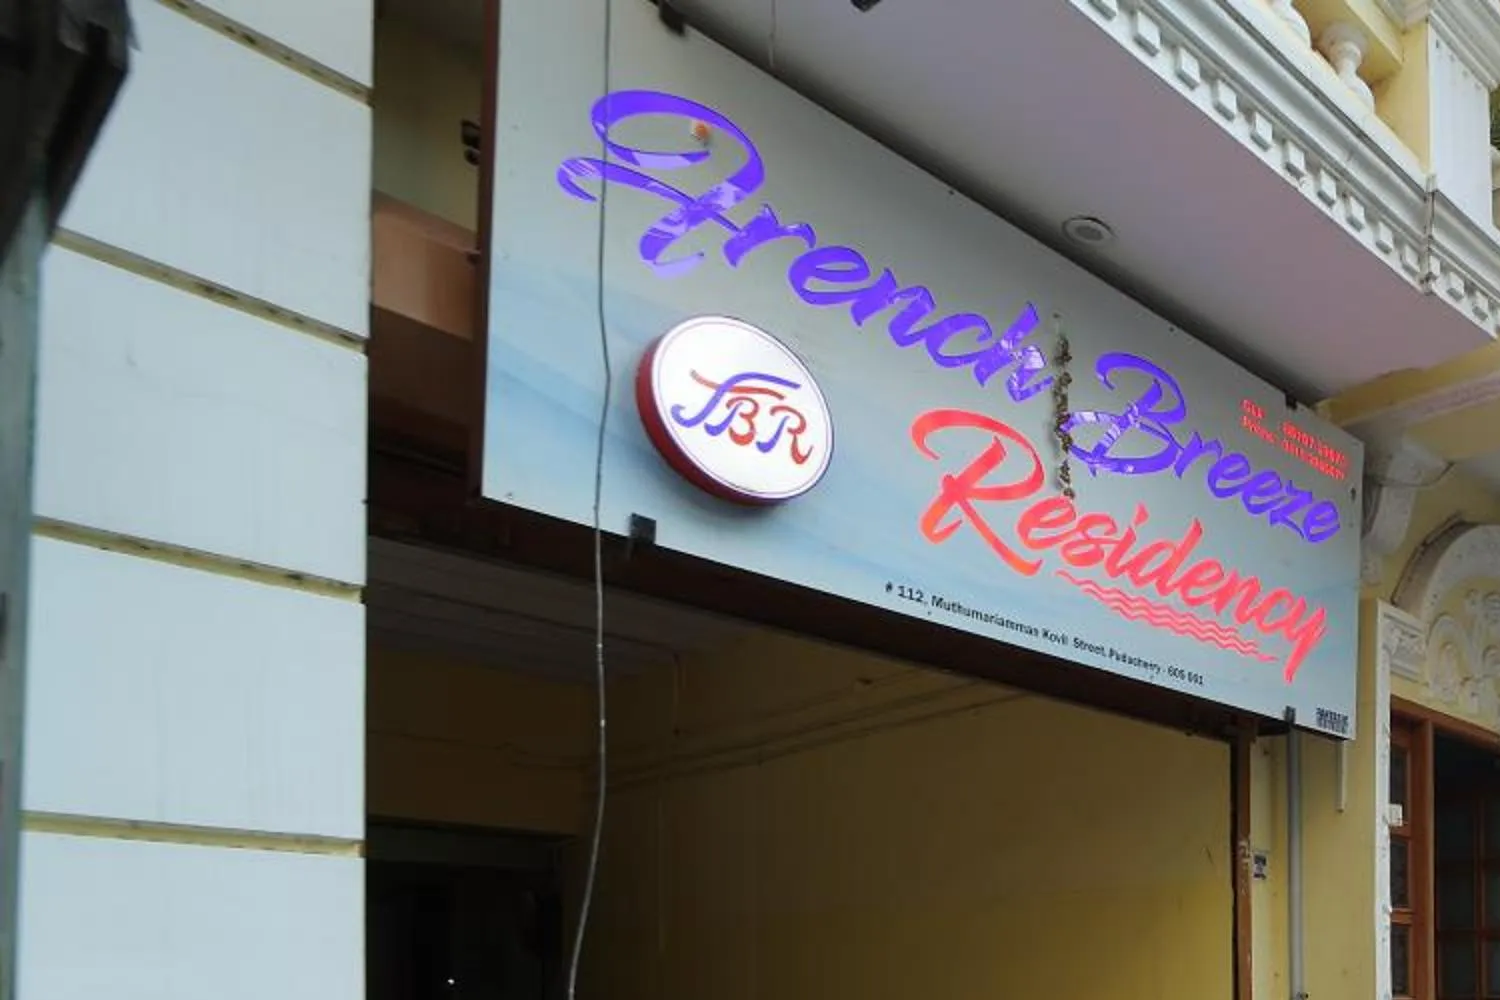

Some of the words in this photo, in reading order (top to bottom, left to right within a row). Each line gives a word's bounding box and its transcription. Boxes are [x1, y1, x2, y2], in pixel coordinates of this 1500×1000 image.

[556, 89, 1054, 401] French
[1059, 351, 1342, 544] Breeze
[910, 408, 1328, 685] Residency
